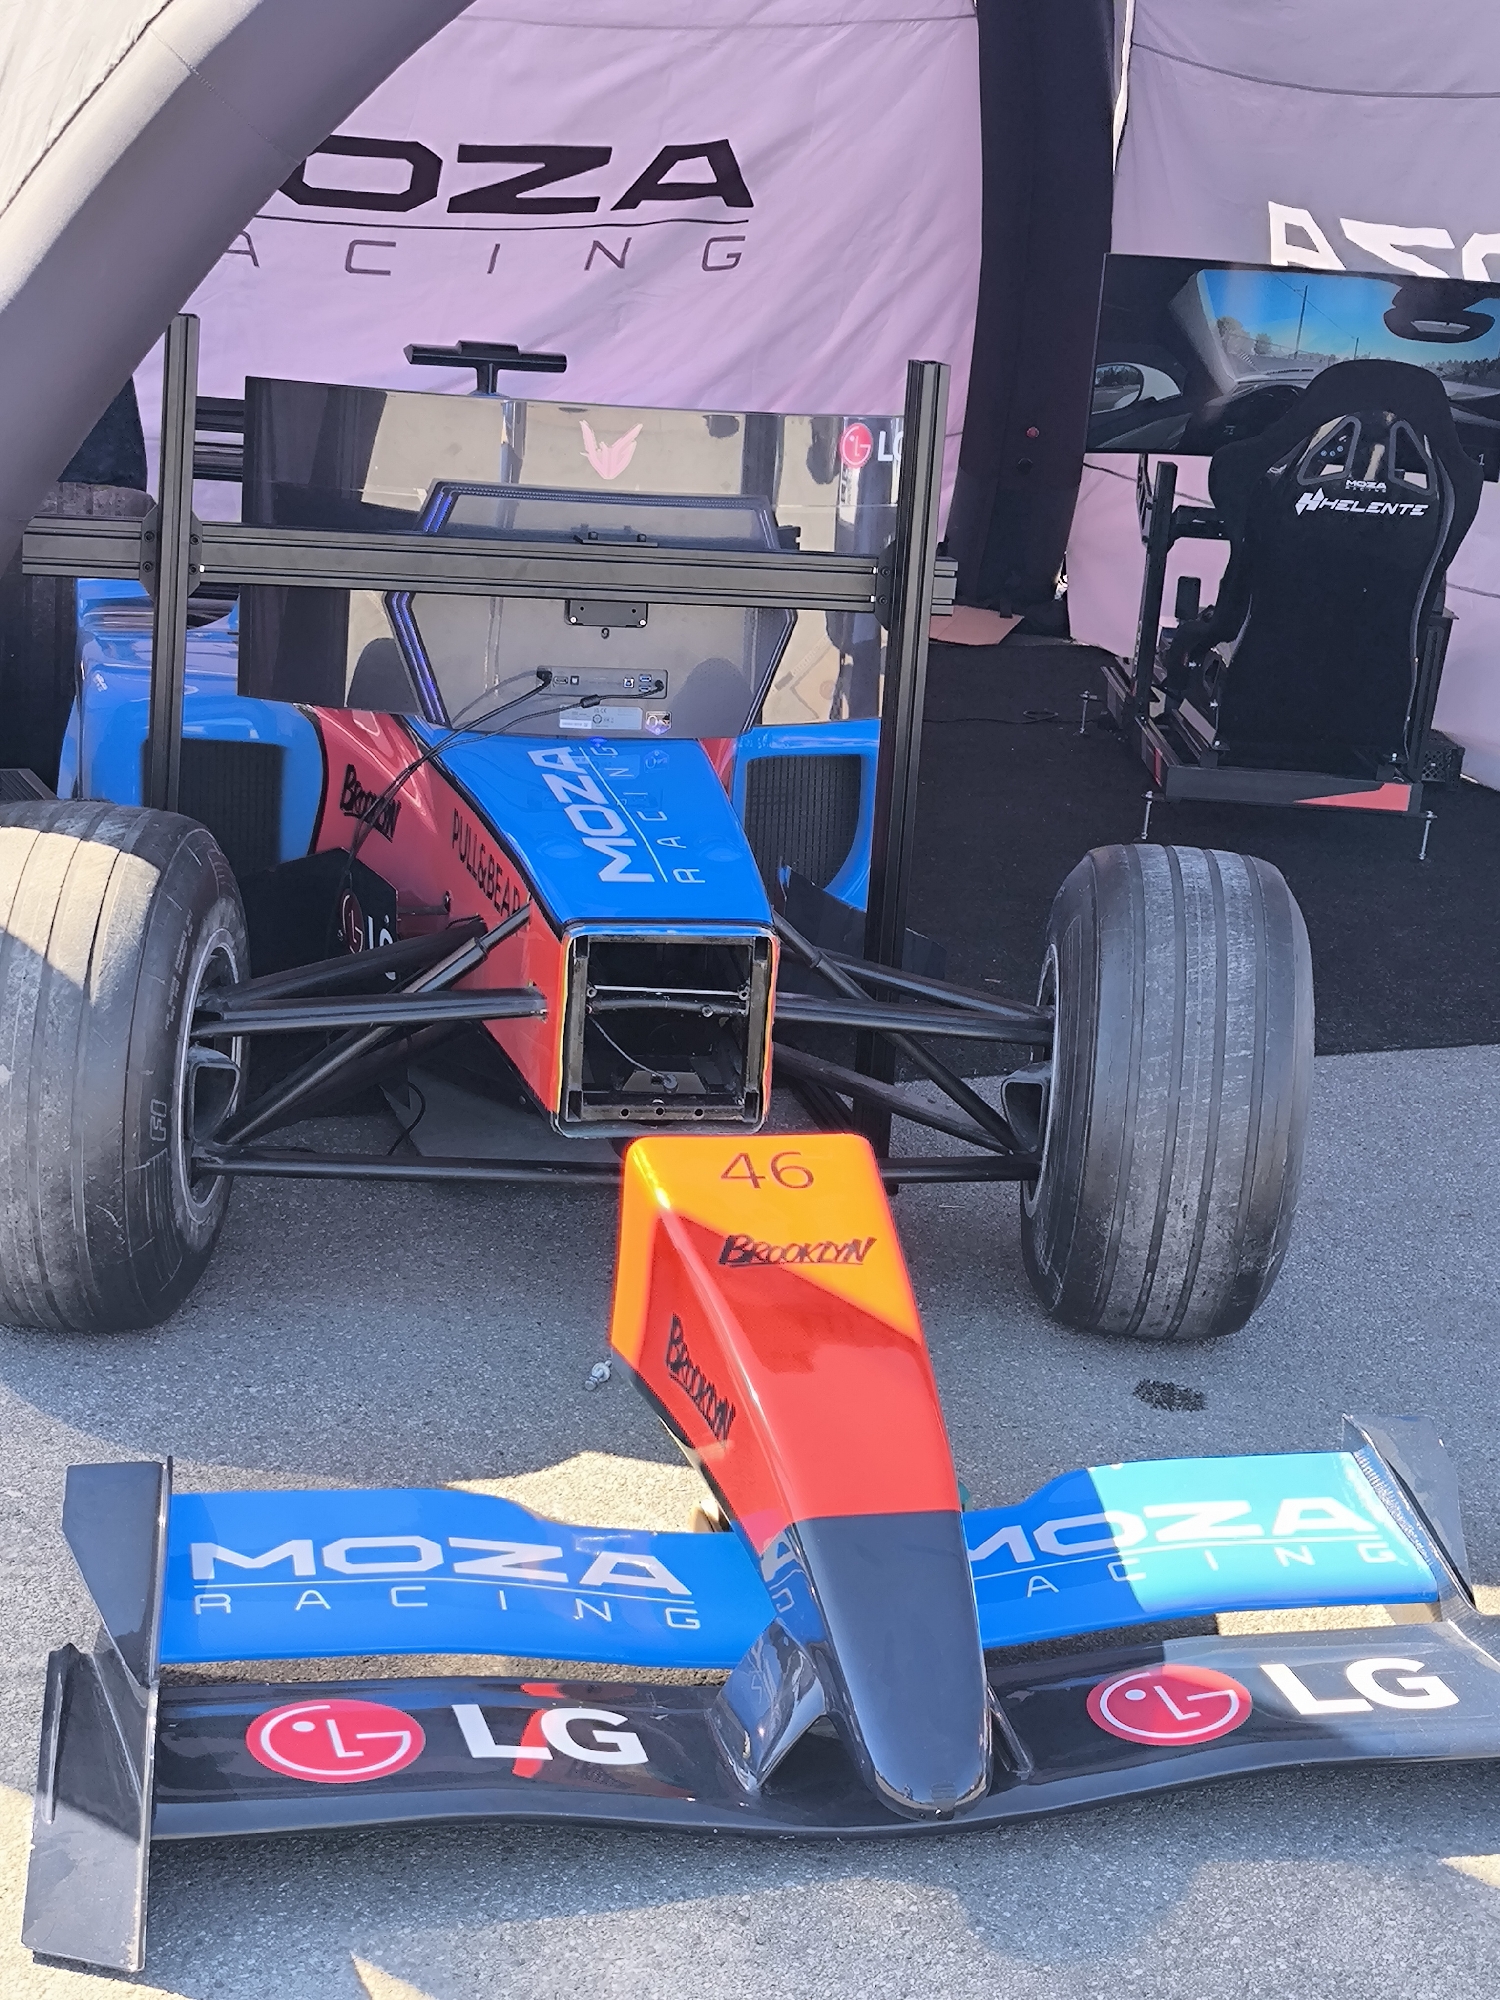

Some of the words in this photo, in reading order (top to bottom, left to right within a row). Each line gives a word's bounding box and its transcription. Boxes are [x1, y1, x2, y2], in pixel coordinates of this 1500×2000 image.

[1345, 480, 1387, 489] MOZA
[527, 746, 655, 883] MOZA
[590, 746, 706, 884] RACING
[720, 1151, 815, 1189] 46
[718, 1233, 878, 1268] BROOKLYN
[190, 1535, 693, 1596] MOZA
[193, 1585, 701, 1630] RACING
[1260, 1657, 1460, 1716] LG
[450, 1702, 649, 1765] LG
